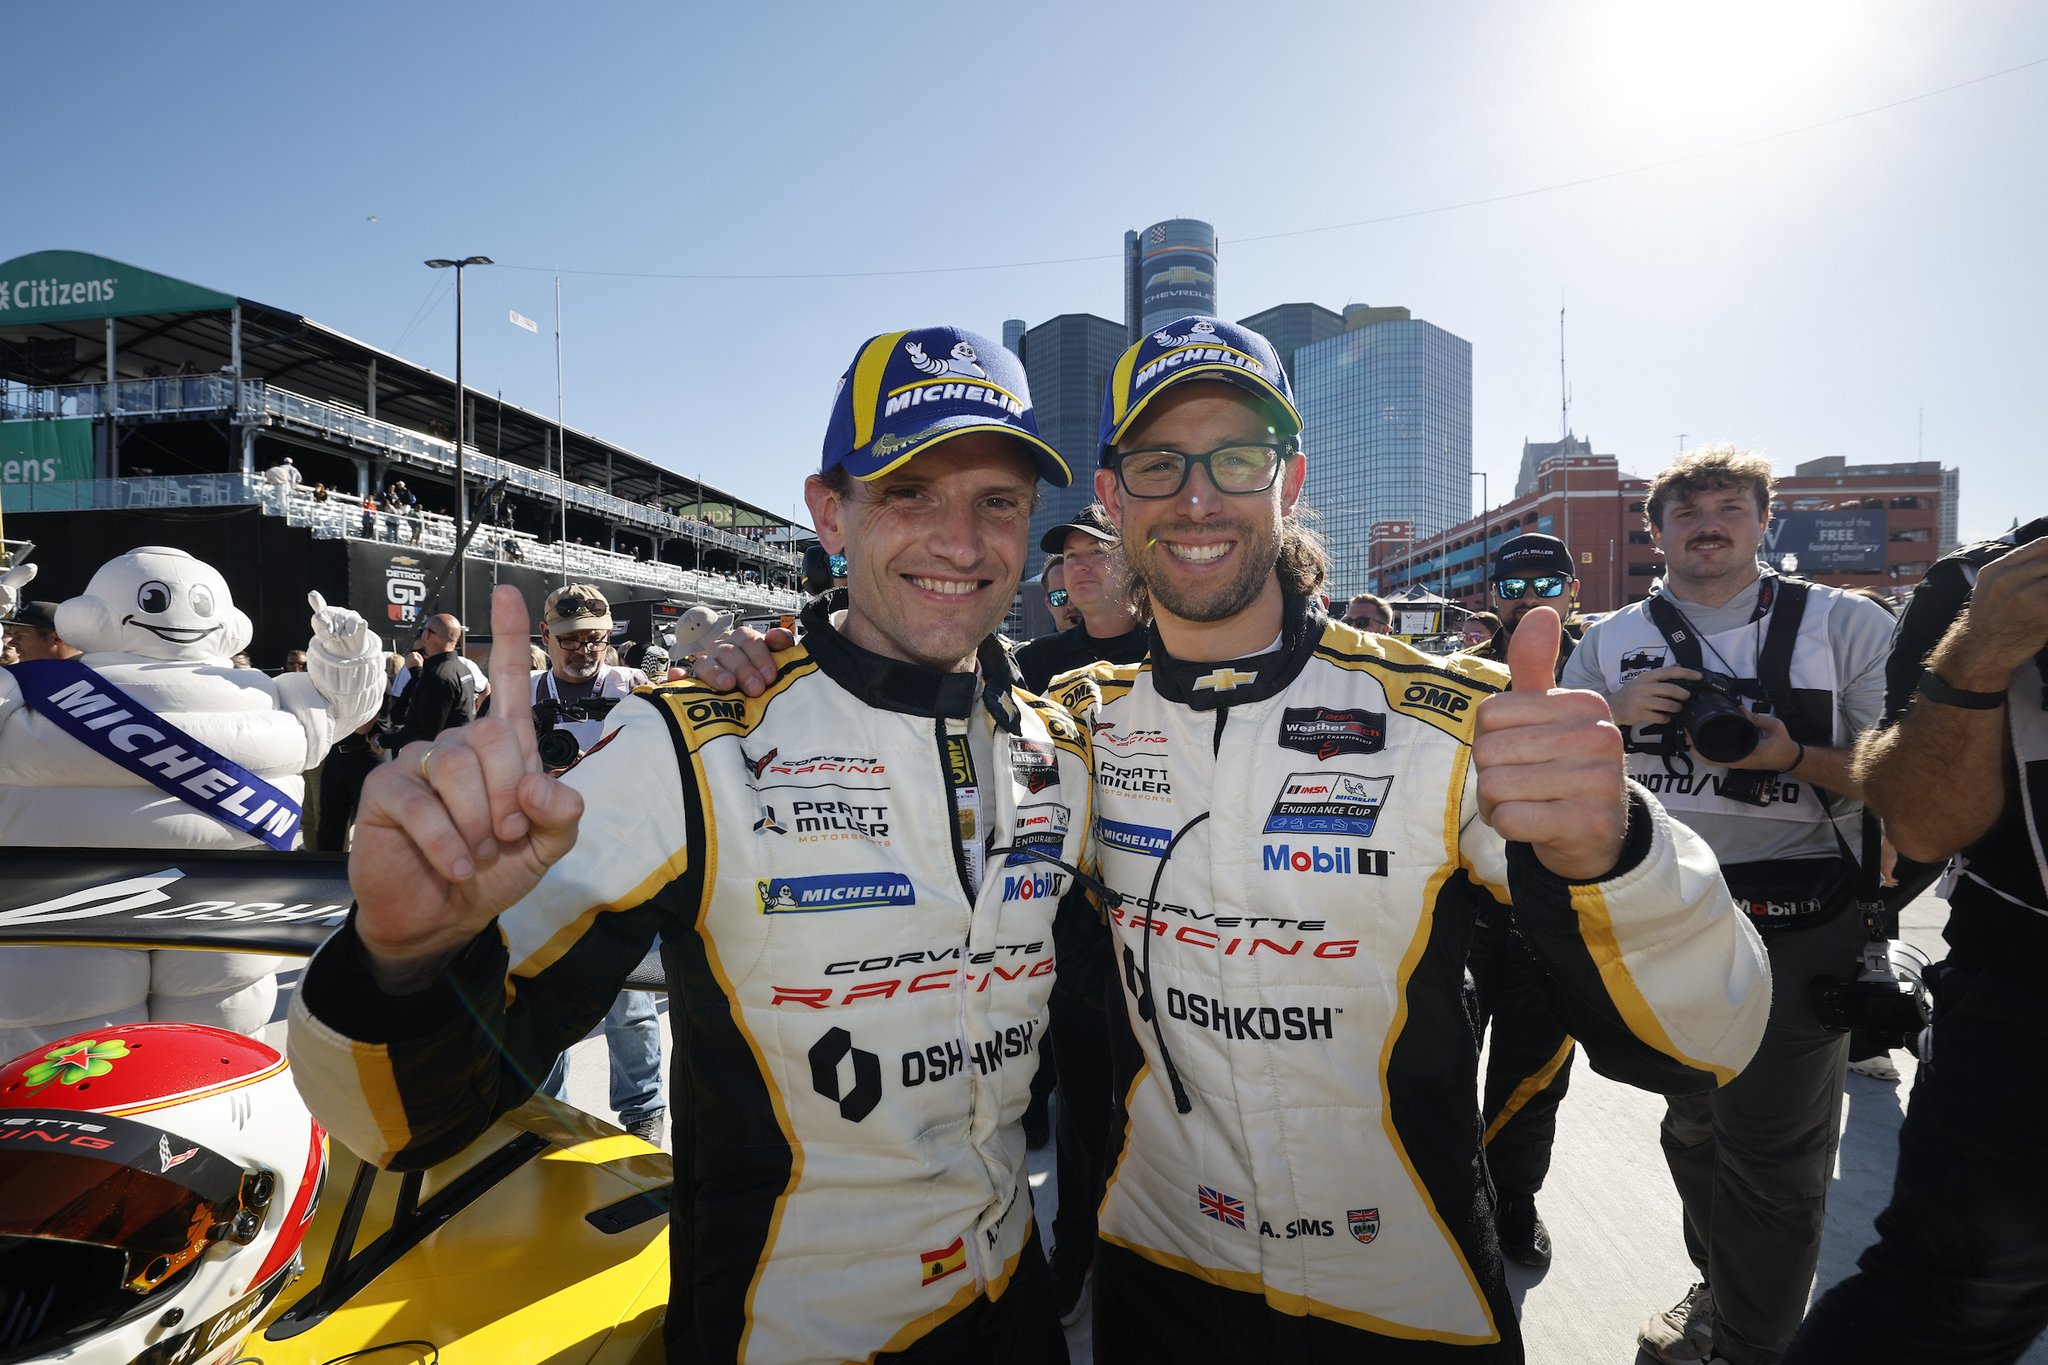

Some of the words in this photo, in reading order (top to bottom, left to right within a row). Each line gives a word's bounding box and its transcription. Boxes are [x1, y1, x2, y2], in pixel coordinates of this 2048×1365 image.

[13, 278, 114, 308] Citizens
[1144, 290, 1214, 304] CHEVROLE
[1136, 348, 1263, 390] MICHELIN
[885, 384, 1023, 419] MICHELIN
[1815, 519, 1841, 527] Home
[1845, 517, 1855, 527] of
[1857, 518, 1871, 527] the
[1820, 530, 1854, 541] FREE
[1808, 543, 1839, 551] fastest
[1841, 544, 1880, 552] delivery
[386, 569, 426, 581] DETROIT
[387, 578, 426, 605] GP
[1711, 682, 1726, 692] SONY
[1404, 686, 1469, 714] OMP
[687, 701, 745, 722] OMP
[1286, 723, 1380, 737] WeatherTech
[47, 680, 298, 838] MICHELIN
[782, 756, 877, 766] CORVETTE
[770, 763, 885, 775] RACING
[1100, 761, 1168, 780] PRATT
[1100, 774, 1171, 795] MILLER
[1300, 786, 1329, 794] IMSA
[1101, 789, 1172, 803] MOTORSPORTS
[1335, 794, 1378, 803] MICHELIN
[792, 801, 888, 820] PRATT
[1280, 804, 1345, 815] ENDURANCE
[1347, 806, 1371, 816] CUP
[796, 817, 889, 837] MILLER
[1026, 816, 1050, 826] IMSA
[799, 833, 891, 847] MOTORSPORTS
[1104, 829, 1169, 850] MICHELIN
[1263, 844, 1351, 874] Mobil
[801, 884, 910, 903] MICHELIN
[1002, 872, 1053, 903] Mobil
[1119, 893, 1326, 931] CORVETTE
[1732, 897, 1796, 916] Mobil
[1110, 908, 1359, 959] RACING
[770, 957, 1054, 1009] RACING
[1167, 988, 1333, 1041] OSHKOSH
[0, 1118, 107, 1133] ETTE
[0, 1129, 116, 1150] ING
[1260, 1221, 1281, 1239] A.
[1286, 1219, 1334, 1240] SIMS
